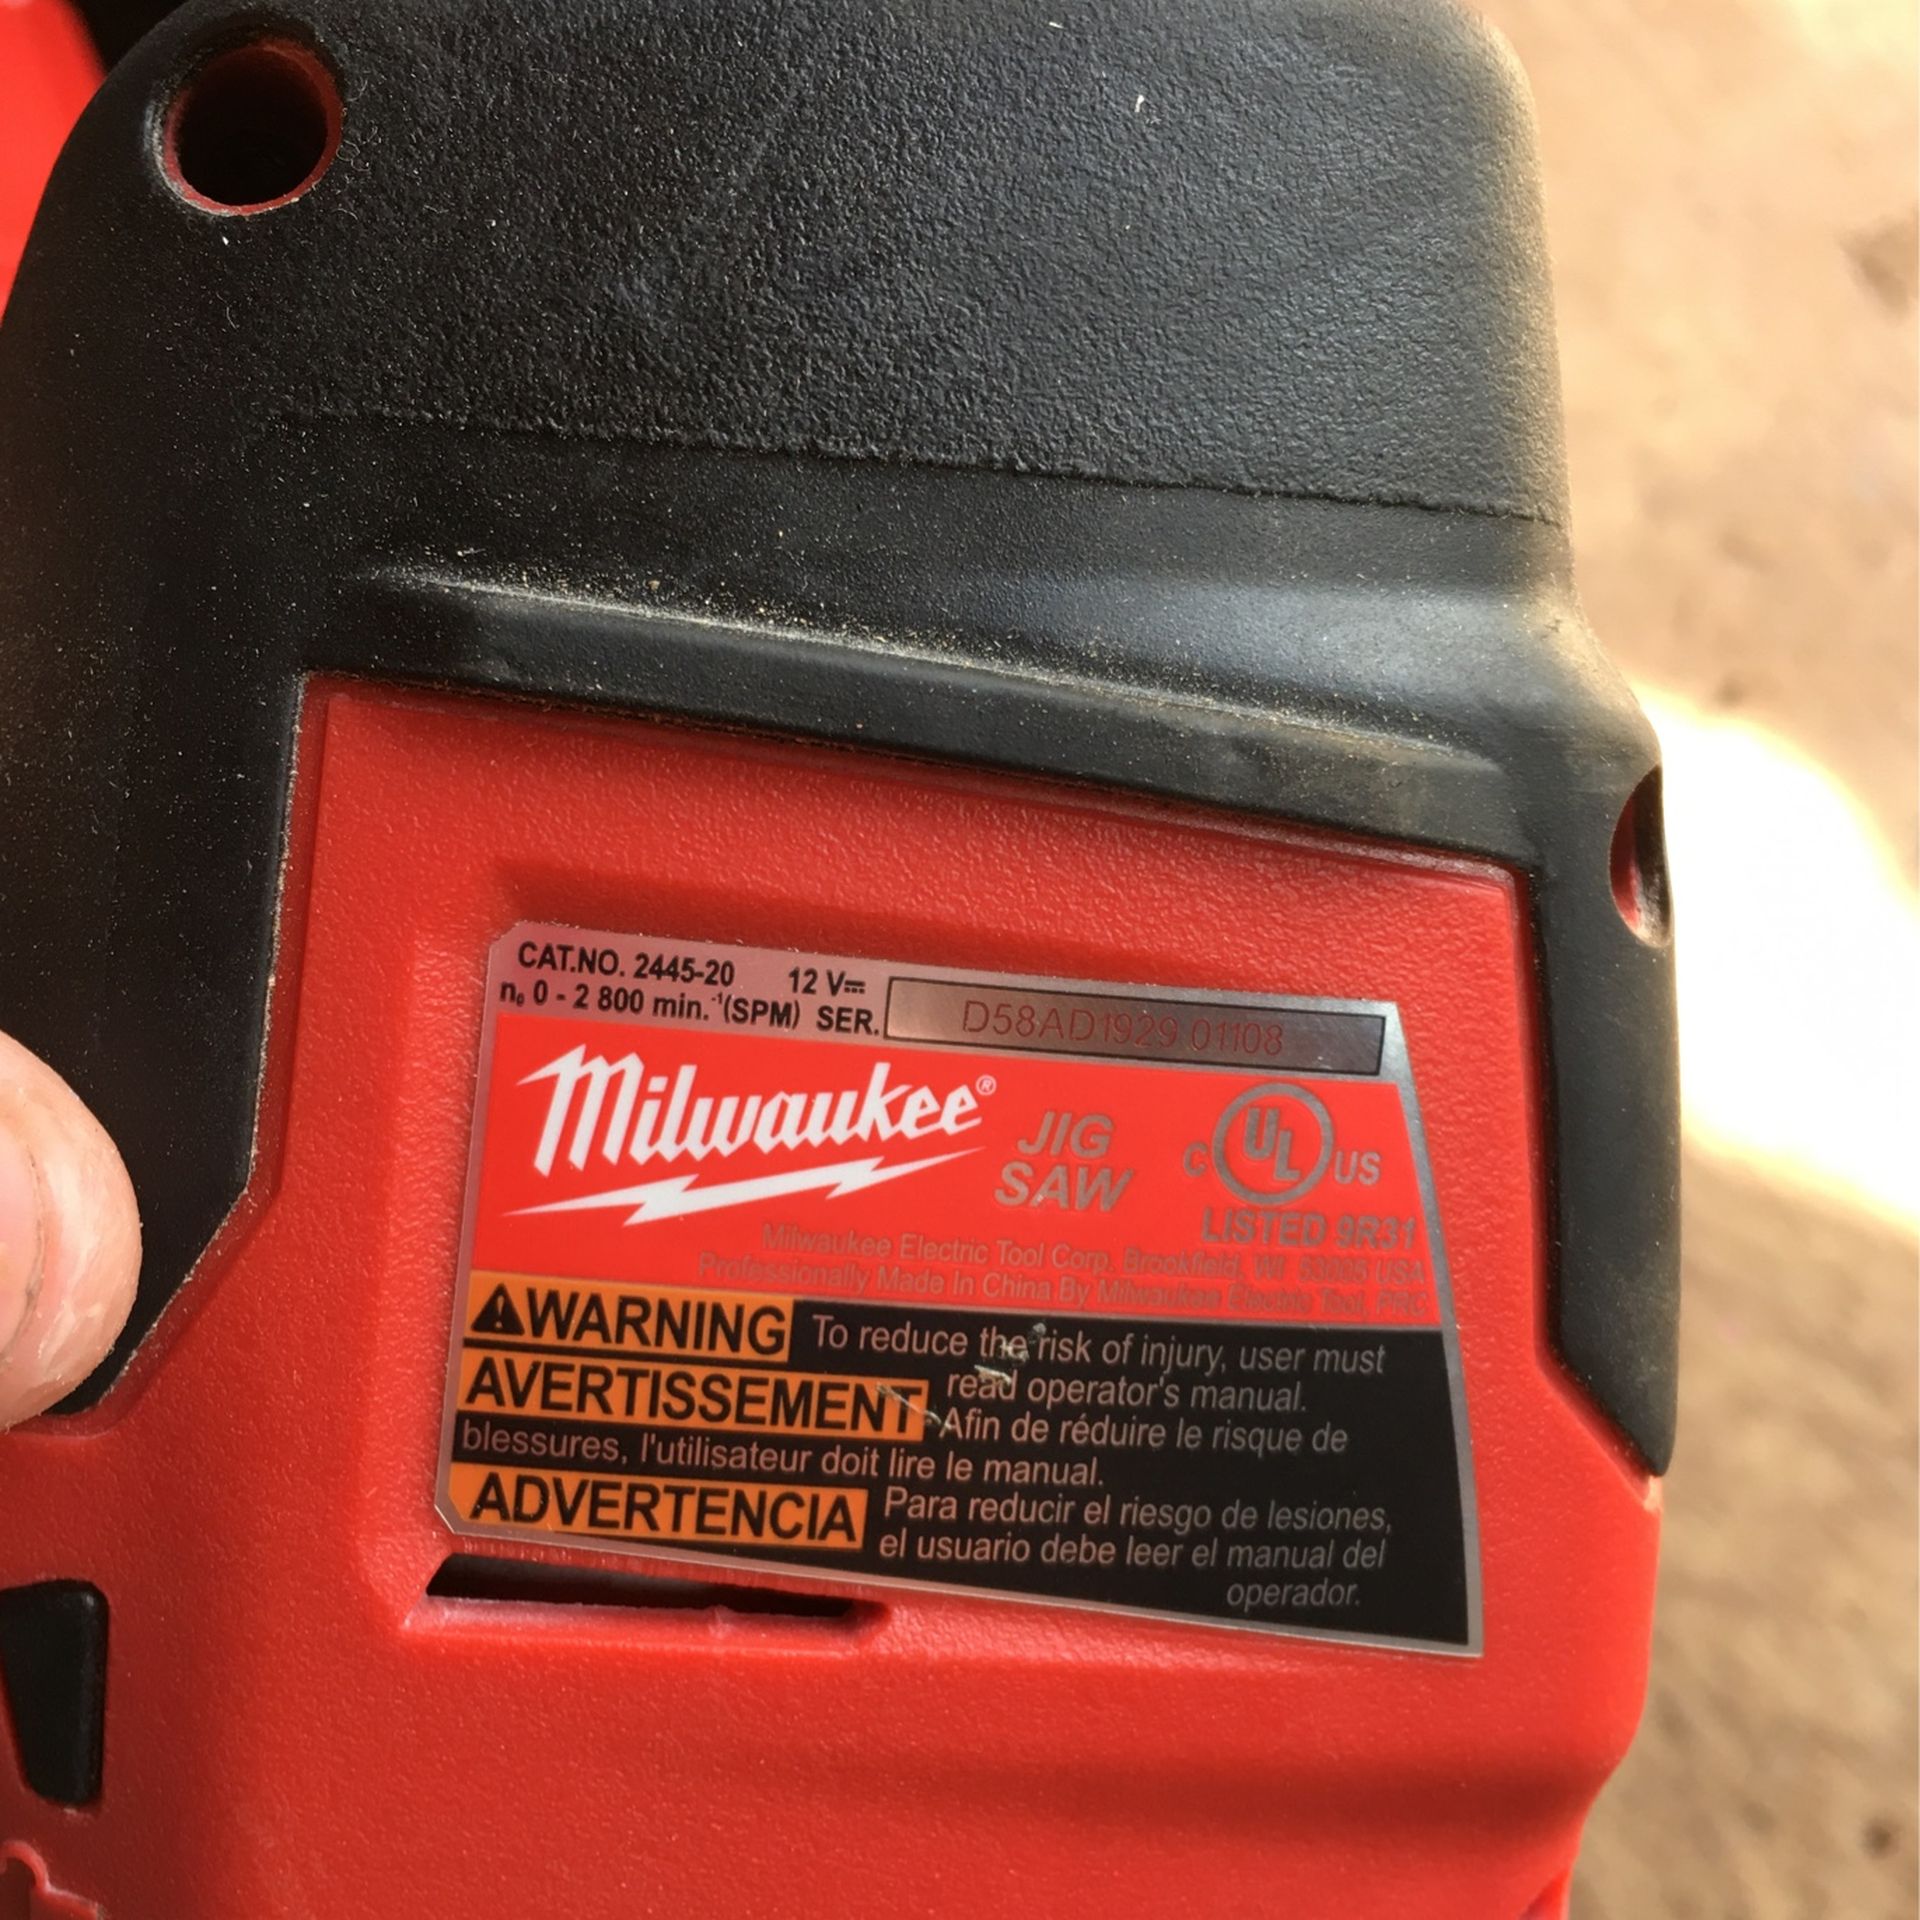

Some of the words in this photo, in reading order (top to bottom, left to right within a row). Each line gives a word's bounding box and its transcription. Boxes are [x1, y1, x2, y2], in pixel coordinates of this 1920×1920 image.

[633, 953, 735, 987] 2445-20
[789, 967, 818, 995] 12
[534, 979, 548, 1004] 0
[573, 983, 589, 1009] 2
[598, 986, 644, 1014] 800
[816, 1005, 879, 1036] SER.
[1191, 1018, 1284, 1056] 01108
[1018, 1111, 1114, 1158] JIG
[1243, 1107, 1301, 1183] UL
[995, 1162, 1133, 1212] SAW
[762, 1223, 891, 1258] Milwaukee
[900, 1233, 988, 1265] Electric
[996, 1240, 1044, 1267] Tool
[1052, 1244, 1114, 1274] Corp.
[1254, 1254, 1284, 1281] WI
[1375, 1258, 1424, 1284] USA
[1202, 1207, 1326, 1247] LISTED
[1337, 1214, 1416, 1249] 9R31
[699, 1252, 870, 1292] Professionally
[877, 1266, 944, 1295] Made
[953, 1270, 974, 1297] In
[982, 1273, 1050, 1300] China
[1059, 1275, 1090, 1307] By
[1100, 1279, 1221, 1310] Milwaukee
[526, 1287, 787, 1355] WARNING
[812, 1314, 848, 1348] To
[859, 1321, 968, 1357] reduce
[980, 1326, 1028, 1361] the
[1038, 1329, 1092, 1363] risk
[1102, 1333, 1134, 1365] of
[1140, 1335, 1227, 1377] injury,
[1239, 1345, 1305, 1371] user
[1313, 1344, 1385, 1374] must
[465, 1356, 923, 1434] AVERTISSEMENT
[939, 1407, 999, 1440] Afin
[1011, 1411, 1048, 1443] de
[1060, 1413, 1166, 1447] réduire
[1176, 1418, 1202, 1449] le
[1212, 1420, 1302, 1458] risque
[1312, 1422, 1348, 1452] de
[947, 1369, 1017, 1400] read
[1028, 1374, 1180, 1410] operator's
[1190, 1381, 1306, 1412] manual.
[462, 1419, 628, 1464] blessures,
[640, 1432, 812, 1474] l'utilisateur
[821, 1445, 879, 1476] doit
[888, 1448, 936, 1480] lire
[946, 1450, 973, 1481] le
[983, 1456, 1104, 1487] manual.
[470, 1472, 856, 1545] ADVERTENCIA
[884, 1486, 957, 1520] Para
[968, 1492, 1075, 1523] reducir
[1083, 1495, 1111, 1525] el
[1119, 1496, 1212, 1536] riesgo
[1221, 1499, 1258, 1530] de
[1267, 1500, 1392, 1534] lesiones,
[879, 1527, 907, 1558] el
[917, 1531, 1030, 1564] usuario
[1040, 1533, 1116, 1564] debe
[1125, 1535, 1184, 1566] leer
[1191, 1537, 1218, 1567] el
[1227, 1539, 1335, 1569] manual
[1342, 1538, 1387, 1569] del
[1226, 1577, 1361, 1613] operador.
